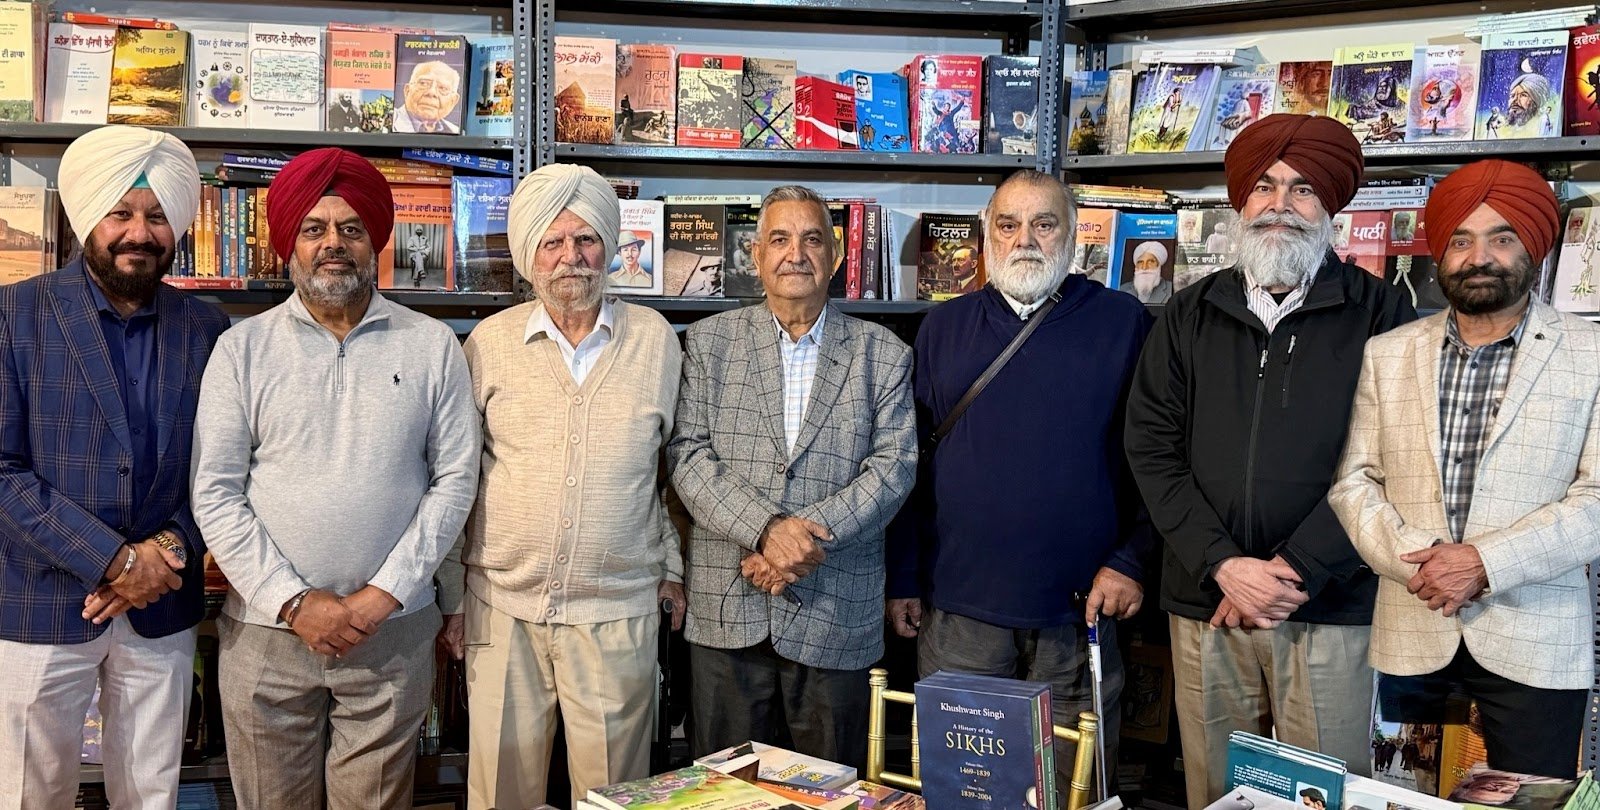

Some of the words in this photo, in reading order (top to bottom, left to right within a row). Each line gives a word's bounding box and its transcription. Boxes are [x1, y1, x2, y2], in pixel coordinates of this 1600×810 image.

[796, 102, 803, 114] 3
[804, 104, 811, 116] 2
[670, 221, 693, 230] ਭਗਤ
[695, 219, 715, 231] ਸਿੰਘ
[929, 223, 971, 239] ਹਿਟਲਰ
[669, 231, 679, 240] ਦੀ
[1186, 256, 1199, 264] ਰਾਤ
[1201, 253, 1217, 264] ਬਾਕੀ
[1218, 254, 1226, 264] ਹੈ
[940, 702, 981, 716] Khushwant
[982, 708, 1005, 720] Singh
[958, 724, 977, 734] History
[946, 731, 1006, 756] SIKHS
